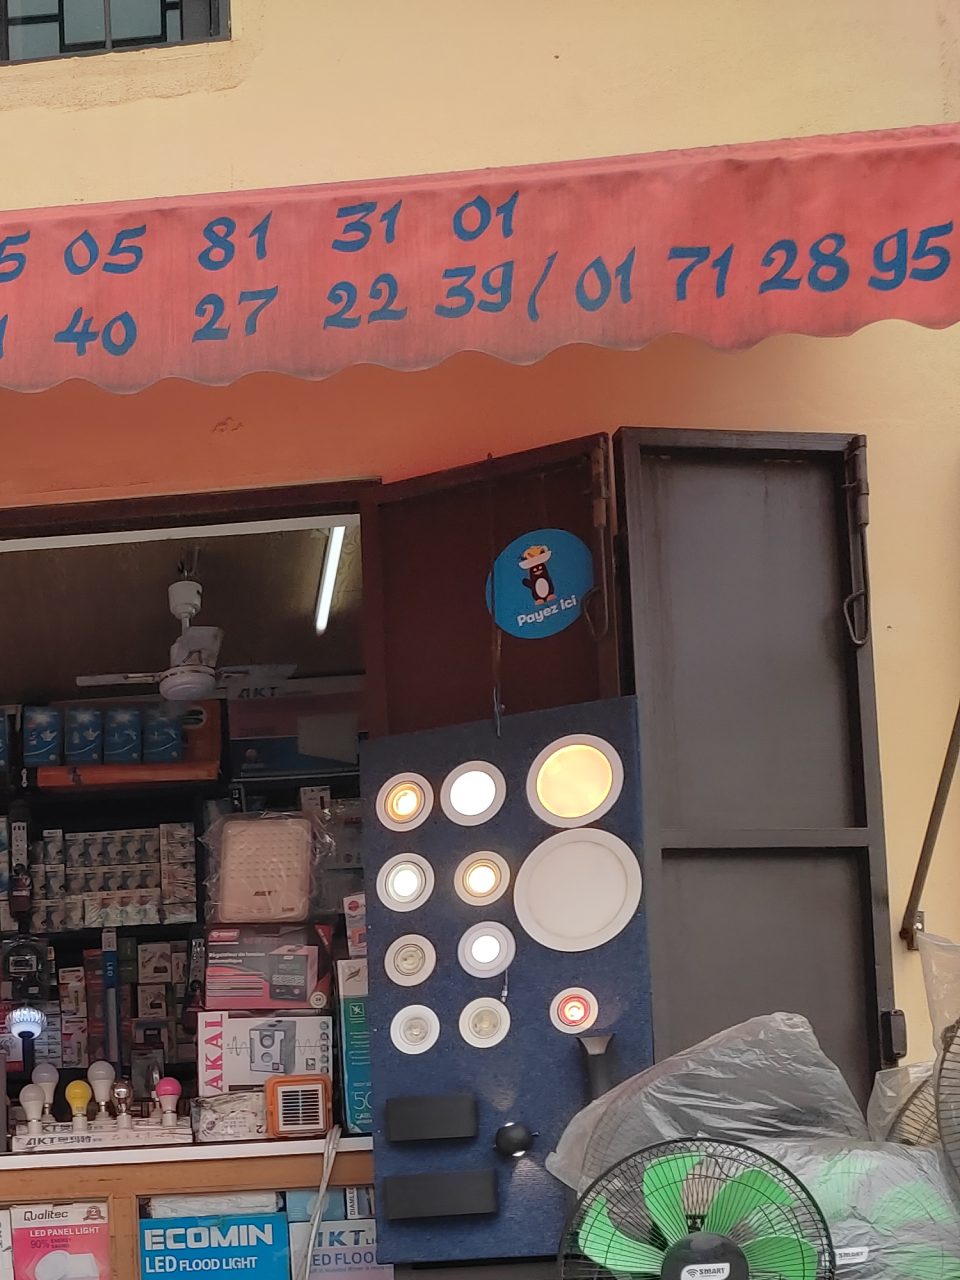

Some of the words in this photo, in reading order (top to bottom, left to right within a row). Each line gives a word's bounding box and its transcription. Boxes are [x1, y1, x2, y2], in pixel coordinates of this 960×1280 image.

[64, 227, 145, 275] 05
[198, 213, 271, 271] 81
[331, 201, 403, 252] 31
[452, 191, 519, 242] 01
[54, 308, 138, 356] 40
[192, 286, 278, 340] 27
[324, 275, 407, 329] 22
[435, 259, 513, 318] 39
[574, 246, 637, 312] 01
[668, 244, 734, 301] 71
[758, 232, 849, 293] 28
[869, 222, 954, 291] 95
[517, 604, 559, 627] Payez
[559, 594, 577, 610] ici
[23, 1209, 69, 1222] Qualitec
[29, 1229, 46, 1237] LED
[47, 1227, 75, 1236] PANEL
[75, 1226, 100, 1235] LIGHT
[144, 1223, 273, 1251] ECOMIN
[145, 1255, 177, 1273] LED
[179, 1258, 220, 1272] FLOOD
[222, 1256, 258, 1270] LIGHT
[312, 1253, 332, 1267] ED
[335, 1251, 375, 1265] FLOO
[698, 1267, 726, 1276] SMART
